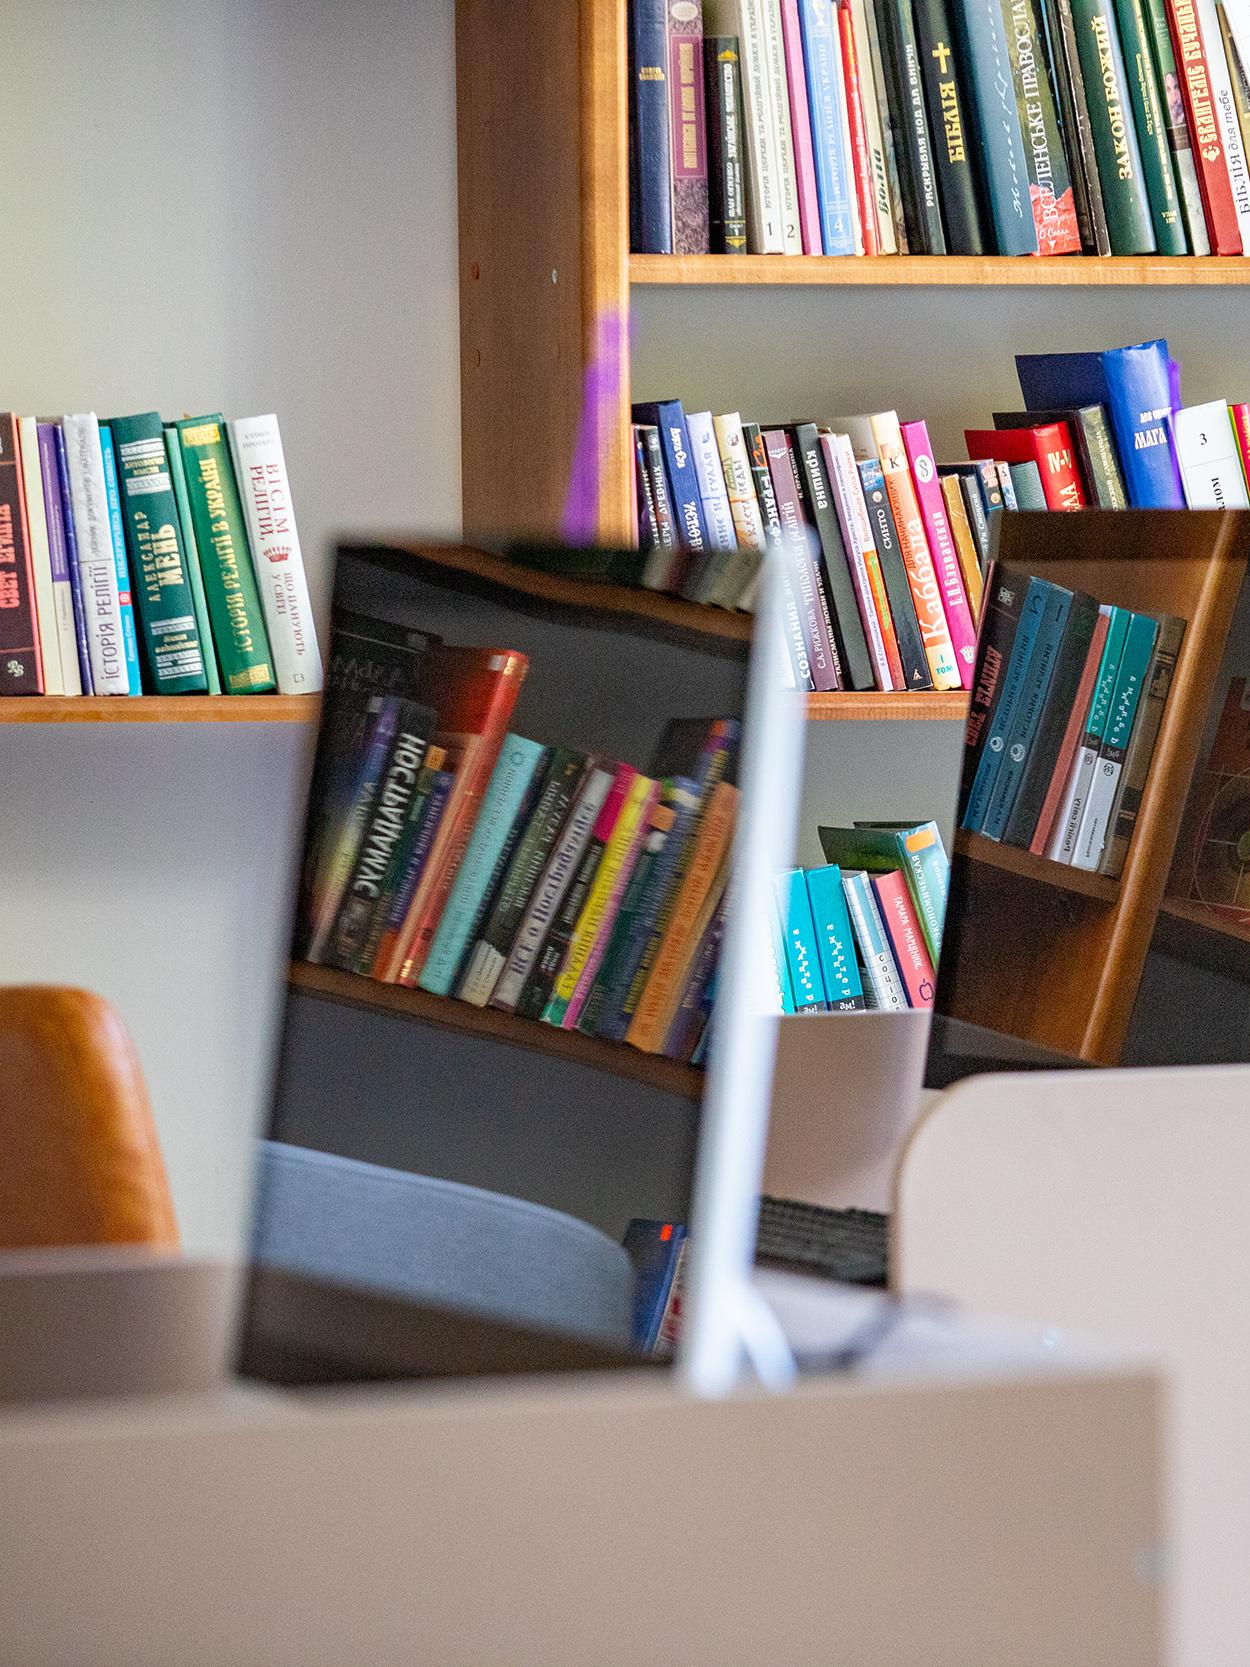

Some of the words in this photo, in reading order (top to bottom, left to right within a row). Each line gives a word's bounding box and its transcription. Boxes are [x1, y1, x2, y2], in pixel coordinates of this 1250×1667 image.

[904, 43, 921, 85] ВИНЧИ
[1090, 14, 1118, 101] БОЖИЙ
[913, 110, 925, 135] КОД
[938, 80, 965, 164] БІБЛІЯ
[1217, 89, 1236, 124] тебе
[1025, 102, 1060, 223] ВСЕЛЕНСЬКЕ
[1106, 103, 1134, 180] ЗАКОН
[1225, 127, 1239, 151] для
[916, 136, 934, 207] РАСКРЫВАЯ
[786, 224, 797, 239] 2
[1198, 432, 1208, 446] 3
[198, 457, 227, 518] УКРАЇНІ
[249, 465, 274, 541] РЕЛІГІЙ,
[265, 463, 290, 534] ВІСІМ
[653, 465, 668, 515] ДРЕВНИХ
[805, 449, 828, 510] кришна
[211, 519, 227, 532] В
[876, 508, 893, 550] СИНТО
[888, 479, 913, 549] НАЧИНАЮЩИХ
[133, 511, 161, 602] АЛЕКСАНДР
[150, 522, 185, 587] МЕНЬ
[210, 534, 241, 588] РЕЛІГІЇ
[902, 548, 917, 570] ДЛЯ
[906, 518, 947, 643] Каббала
[0, 570, 20, 610] СВЕТ
[88, 565, 112, 616] РЕЛІГІЇ
[819, 596, 832, 625] ЛЮБВИ
[225, 592, 254, 653] ІСТОРІЯ
[286, 591, 305, 657] ПАНУЮТЬ
[785, 601, 812, 680] СОЗНАНИЯ
[807, 608, 824, 652] РИЖКОВА
[98, 623, 120, 680] ІСТОРІЯ
[825, 625, 843, 676] ТАЛИСМАНЫ
[936, 665, 953, 675] ТОМ
[893, 894, 909, 926] ТАМАРА
[903, 926, 924, 970] МАРЦЕНЮК
